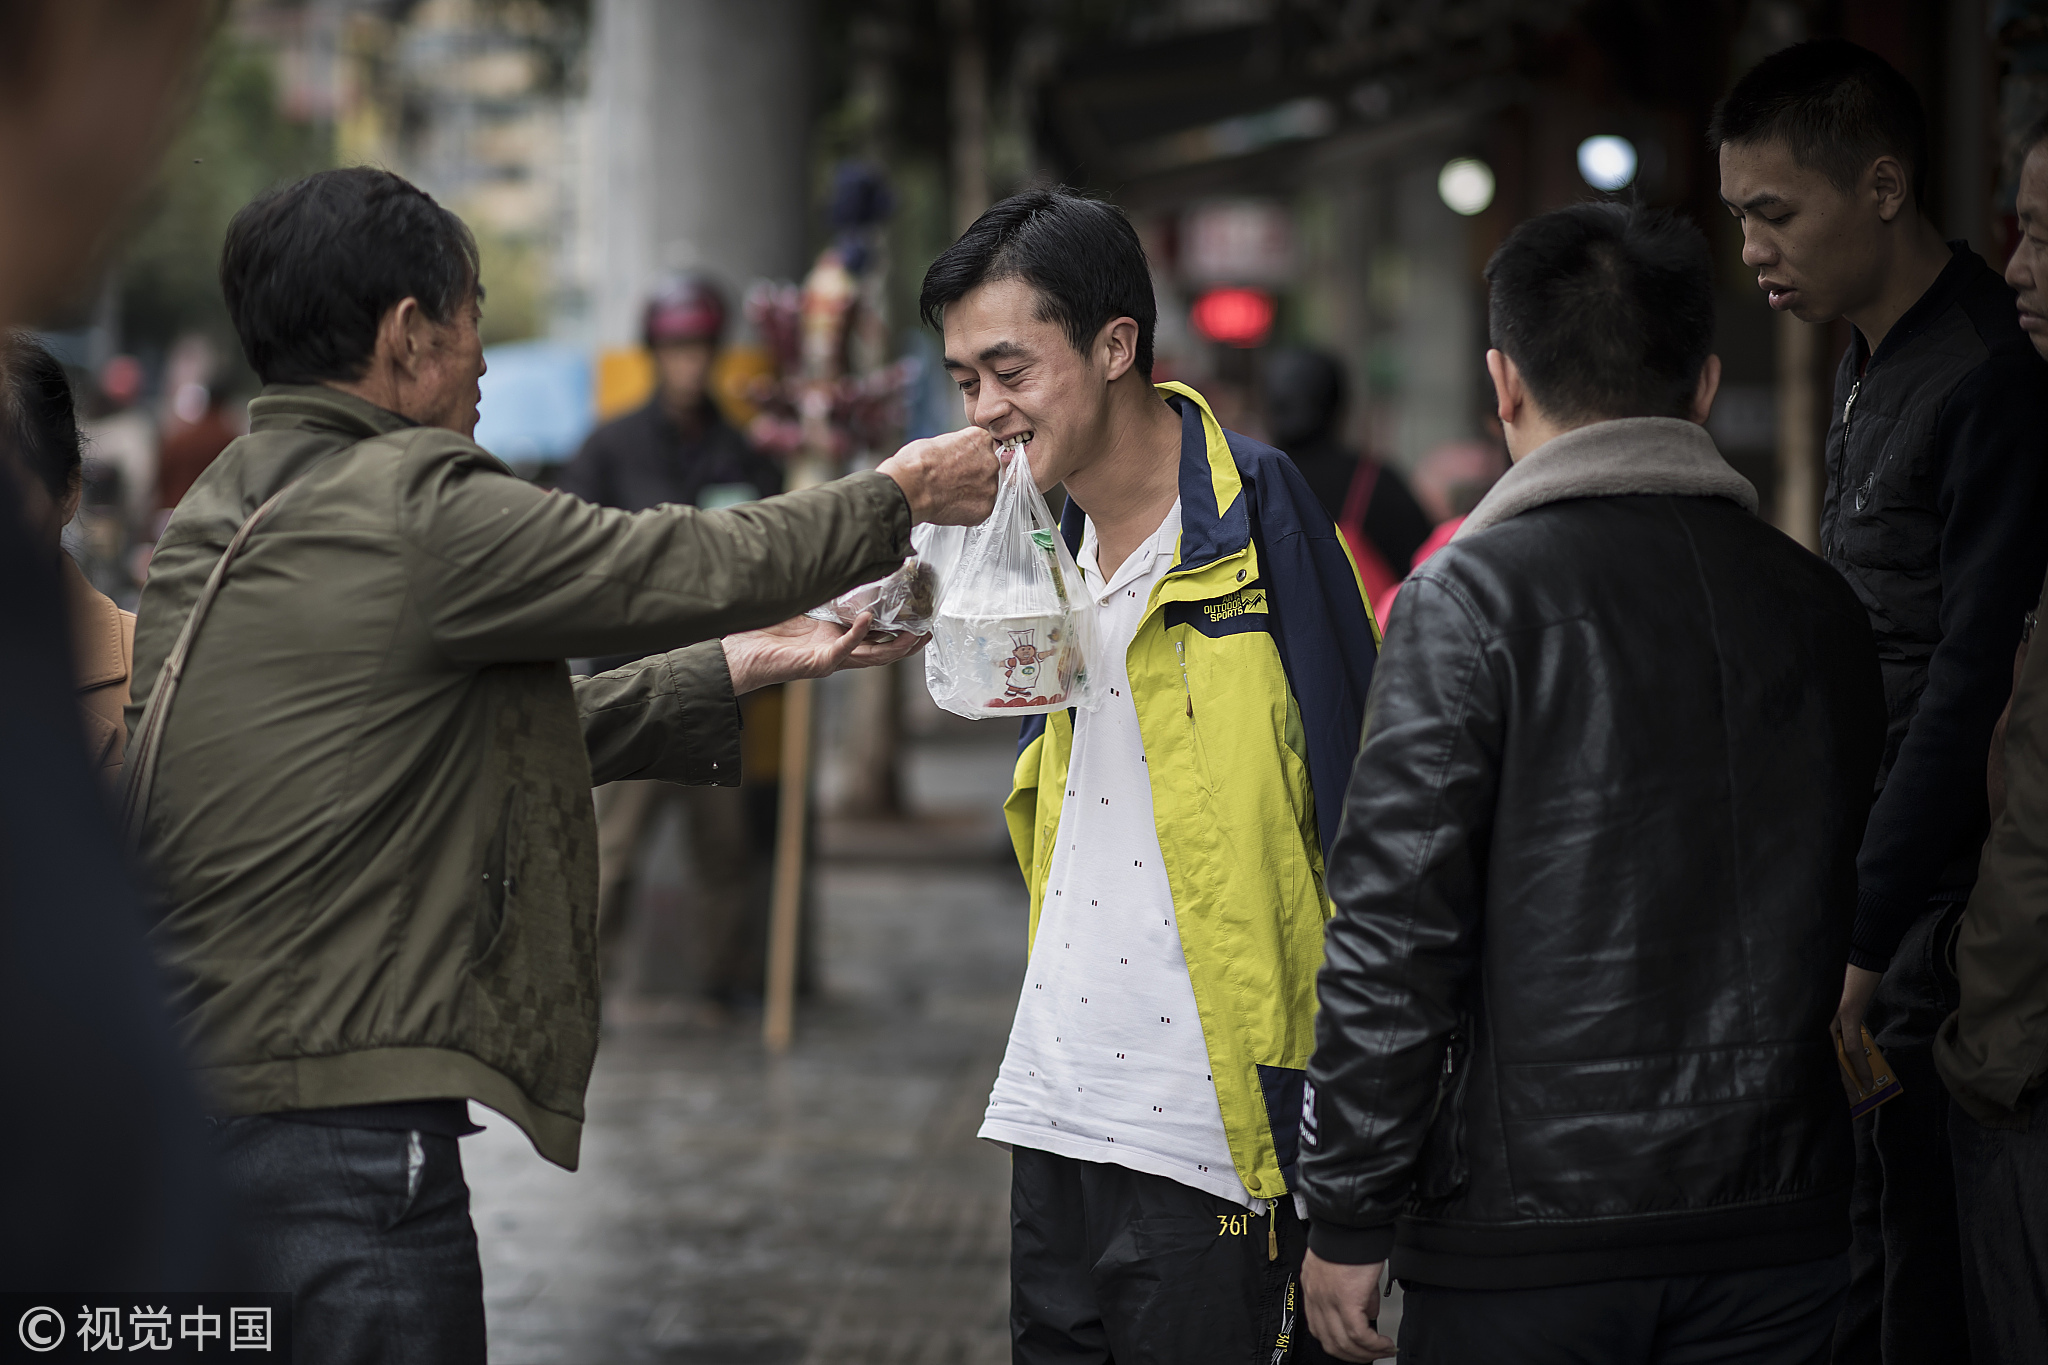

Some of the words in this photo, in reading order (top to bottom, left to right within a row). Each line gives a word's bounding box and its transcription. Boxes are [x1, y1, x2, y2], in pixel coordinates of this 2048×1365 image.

[1203, 597, 1242, 615] OUTDOOR
[1210, 605, 1244, 622] SPORTS
[1286, 1281, 1295, 1312] SPORT
